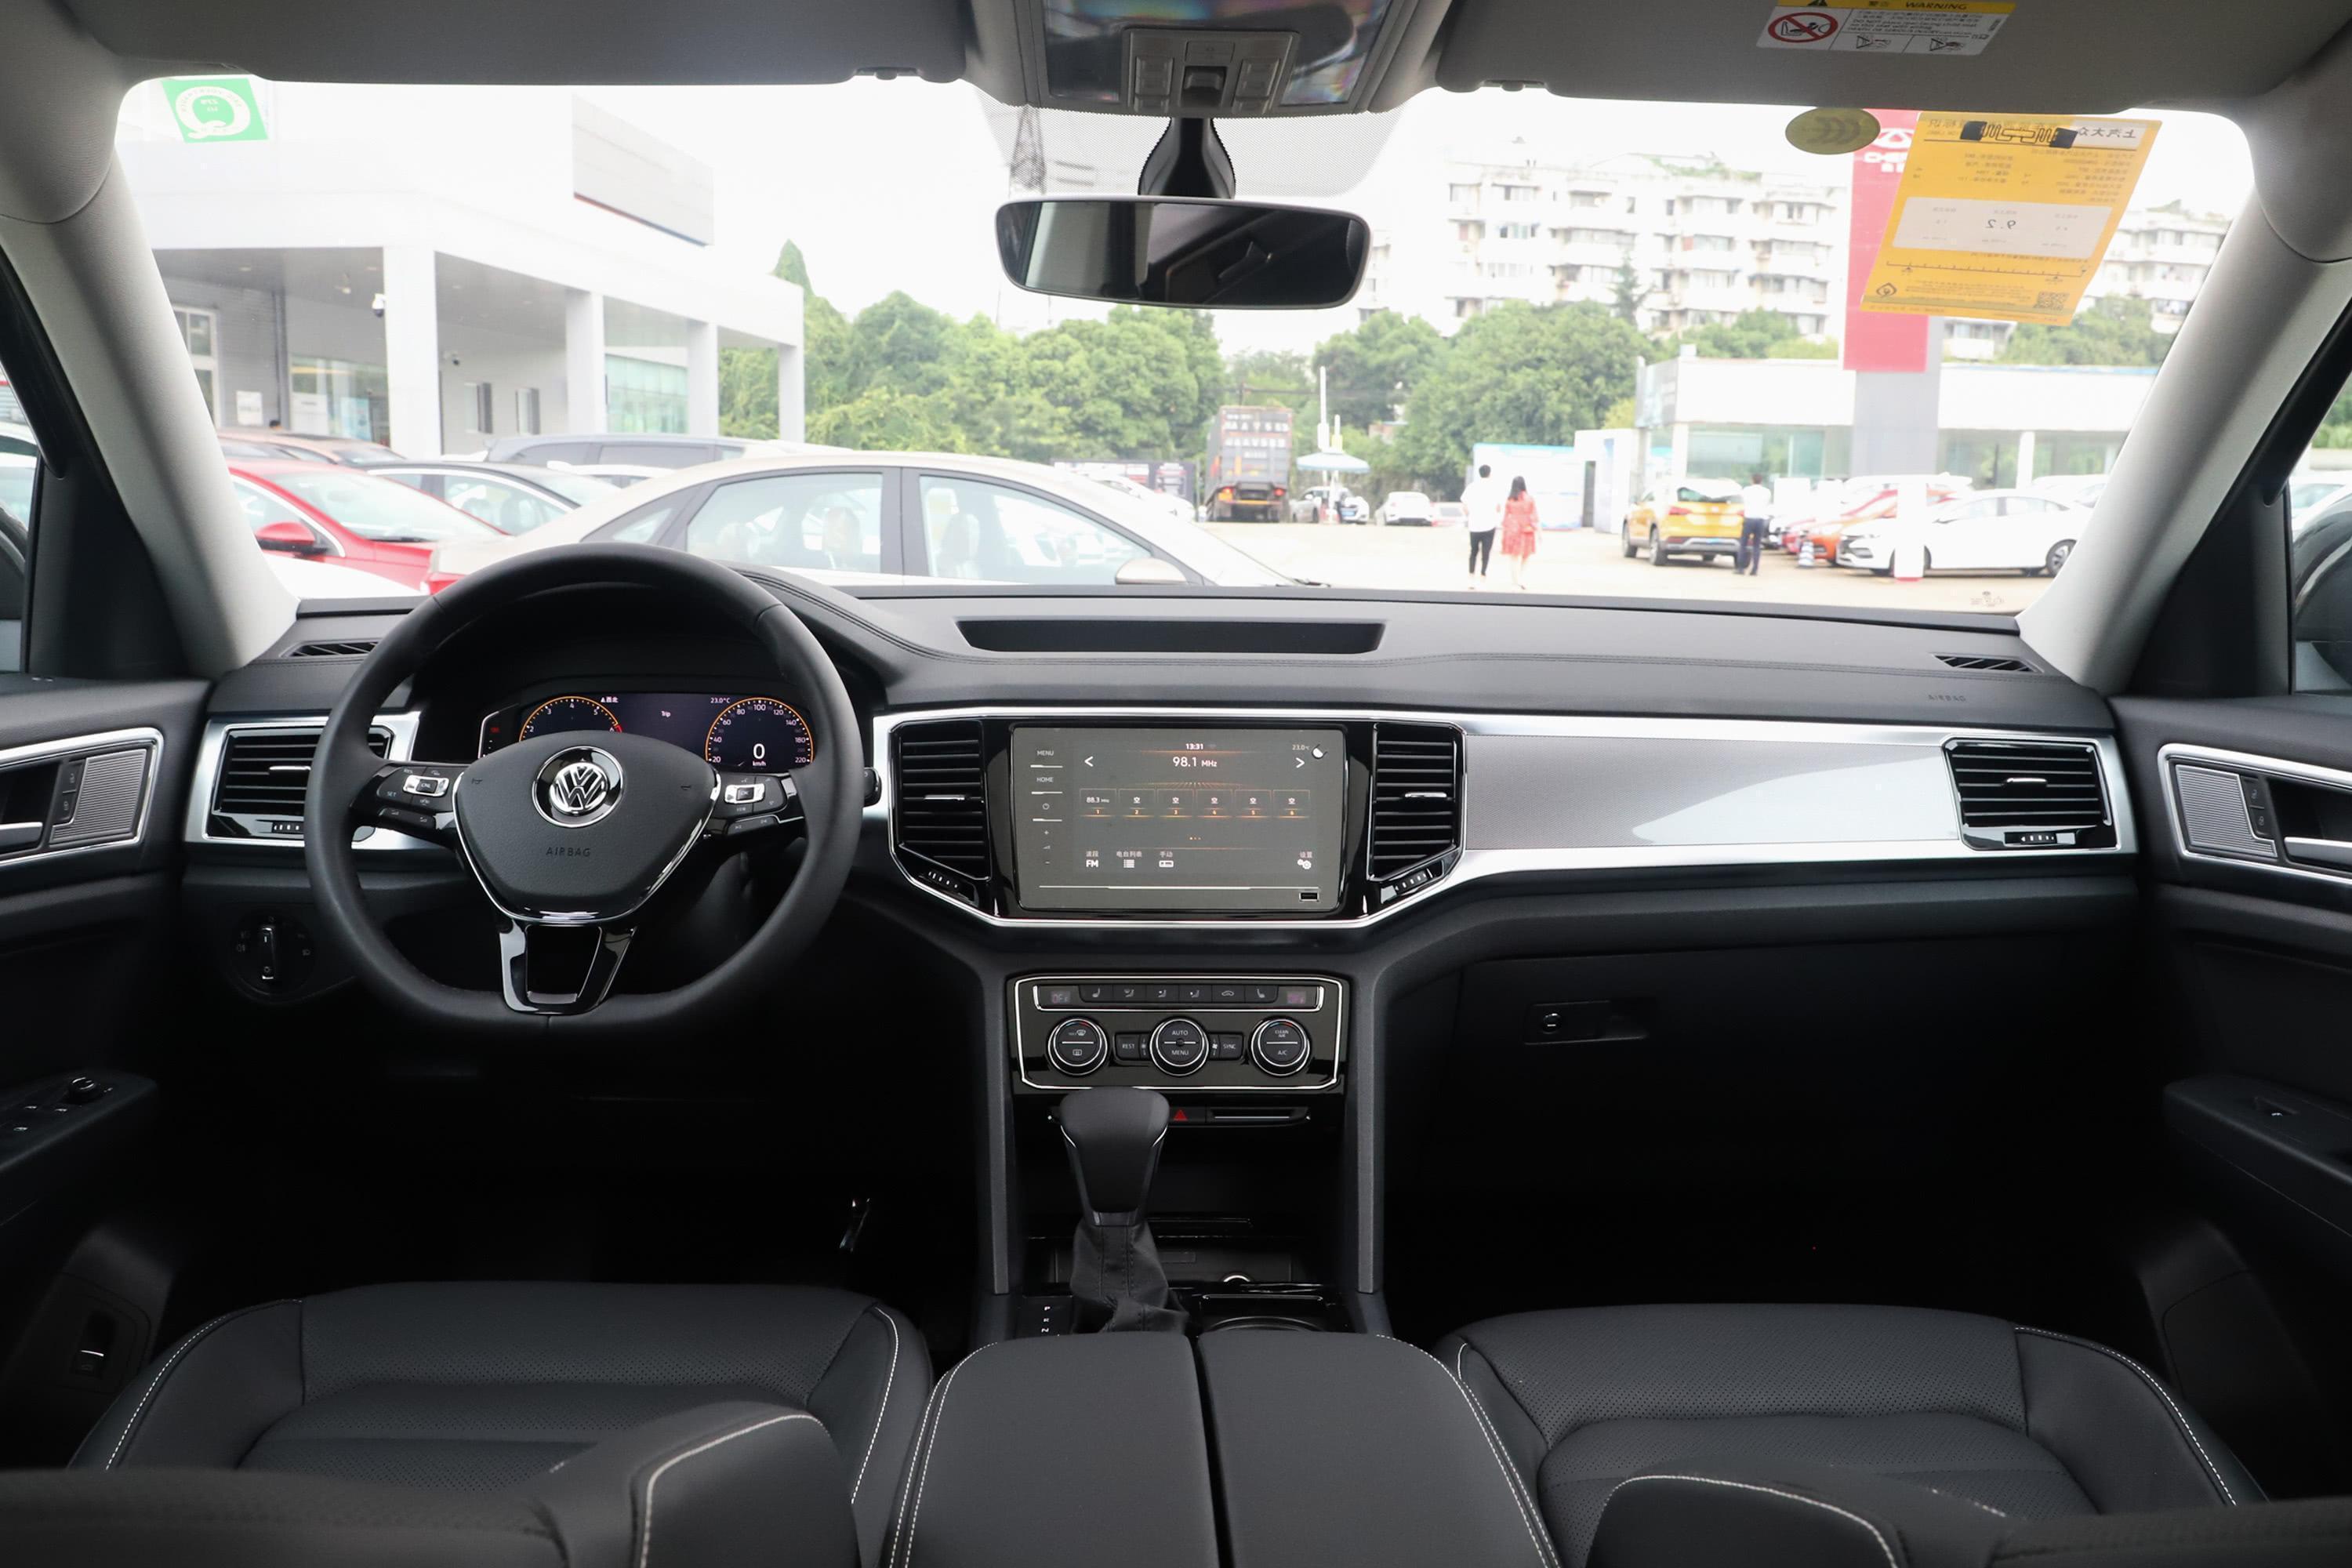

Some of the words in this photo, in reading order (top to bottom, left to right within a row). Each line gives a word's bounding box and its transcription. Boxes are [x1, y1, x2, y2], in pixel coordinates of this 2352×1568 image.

[1906, 1, 1967, 9] WARNING
[753, 743, 765, 760] 0
[1173, 757, 1197, 767] 98.1
[546, 847, 590, 857] AIRBAG
